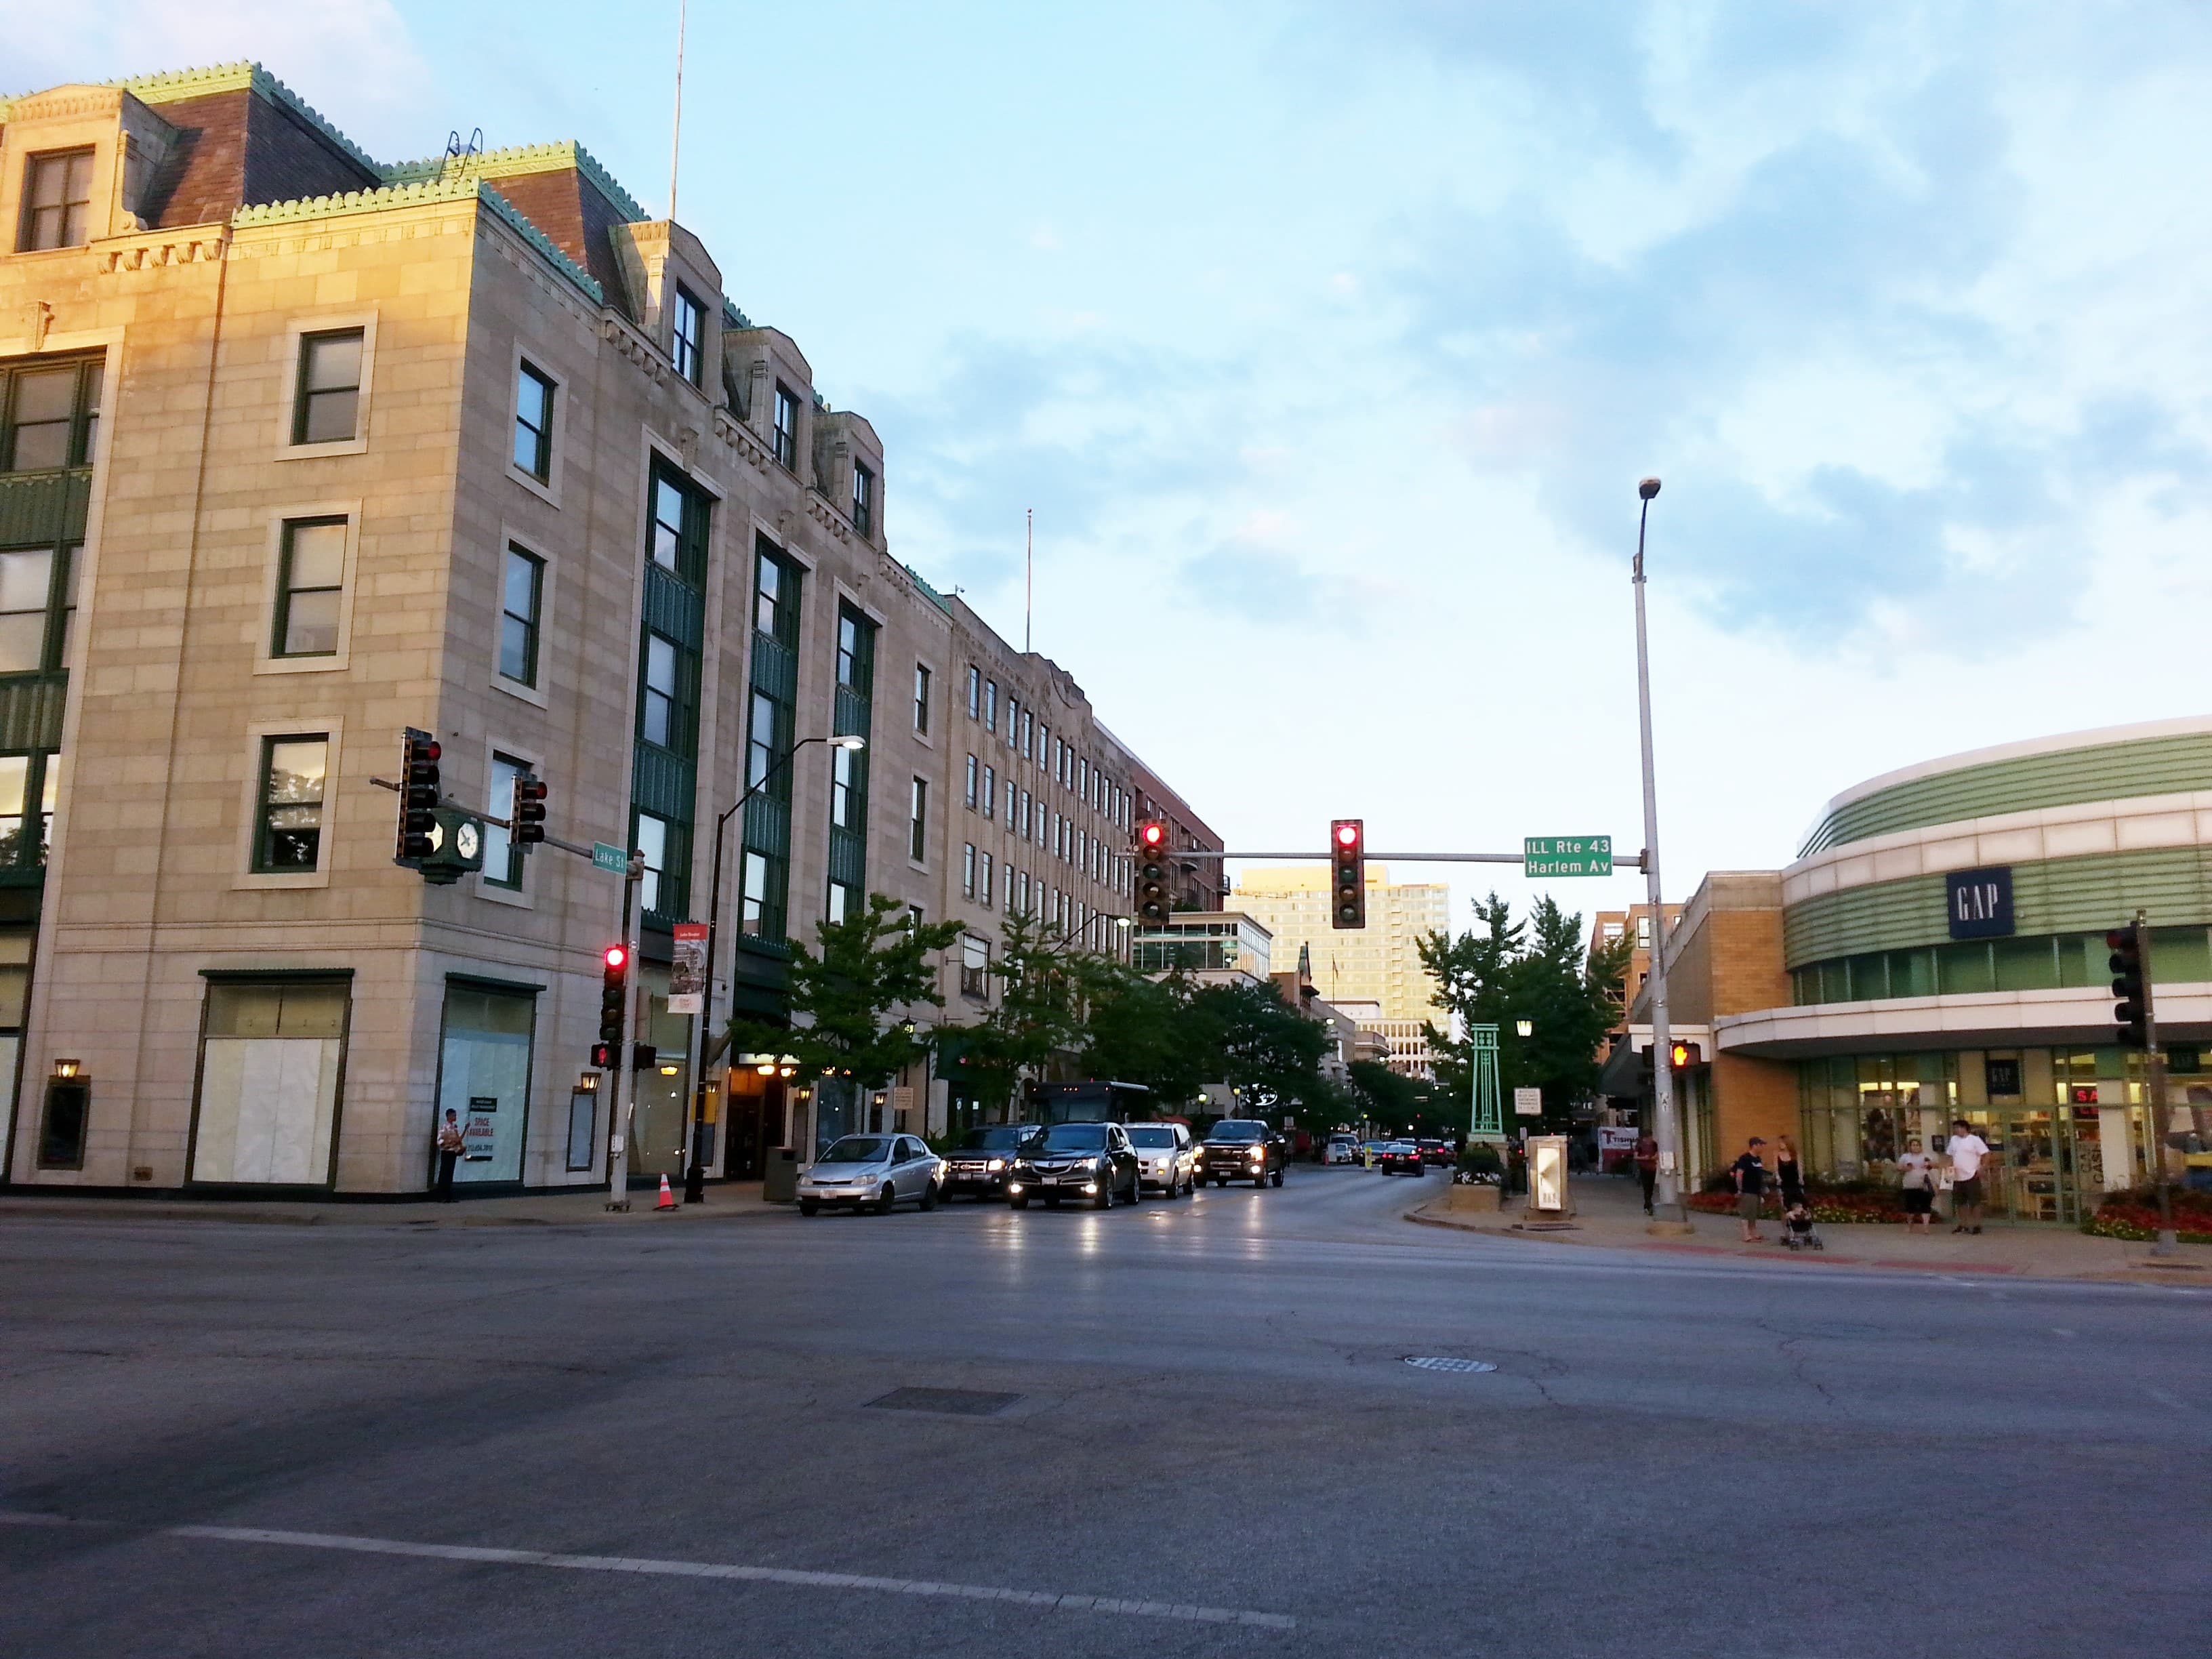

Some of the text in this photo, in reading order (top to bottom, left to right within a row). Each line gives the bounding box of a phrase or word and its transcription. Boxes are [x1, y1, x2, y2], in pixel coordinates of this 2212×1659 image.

[1527, 840, 1610, 854] ILL Rte 43
[595, 848, 624, 869] Lake St
[1528, 859, 1609, 874] Harlem Av
[1957, 883, 1999, 921] GAP
[475, 1118, 489, 1126] SPACE
